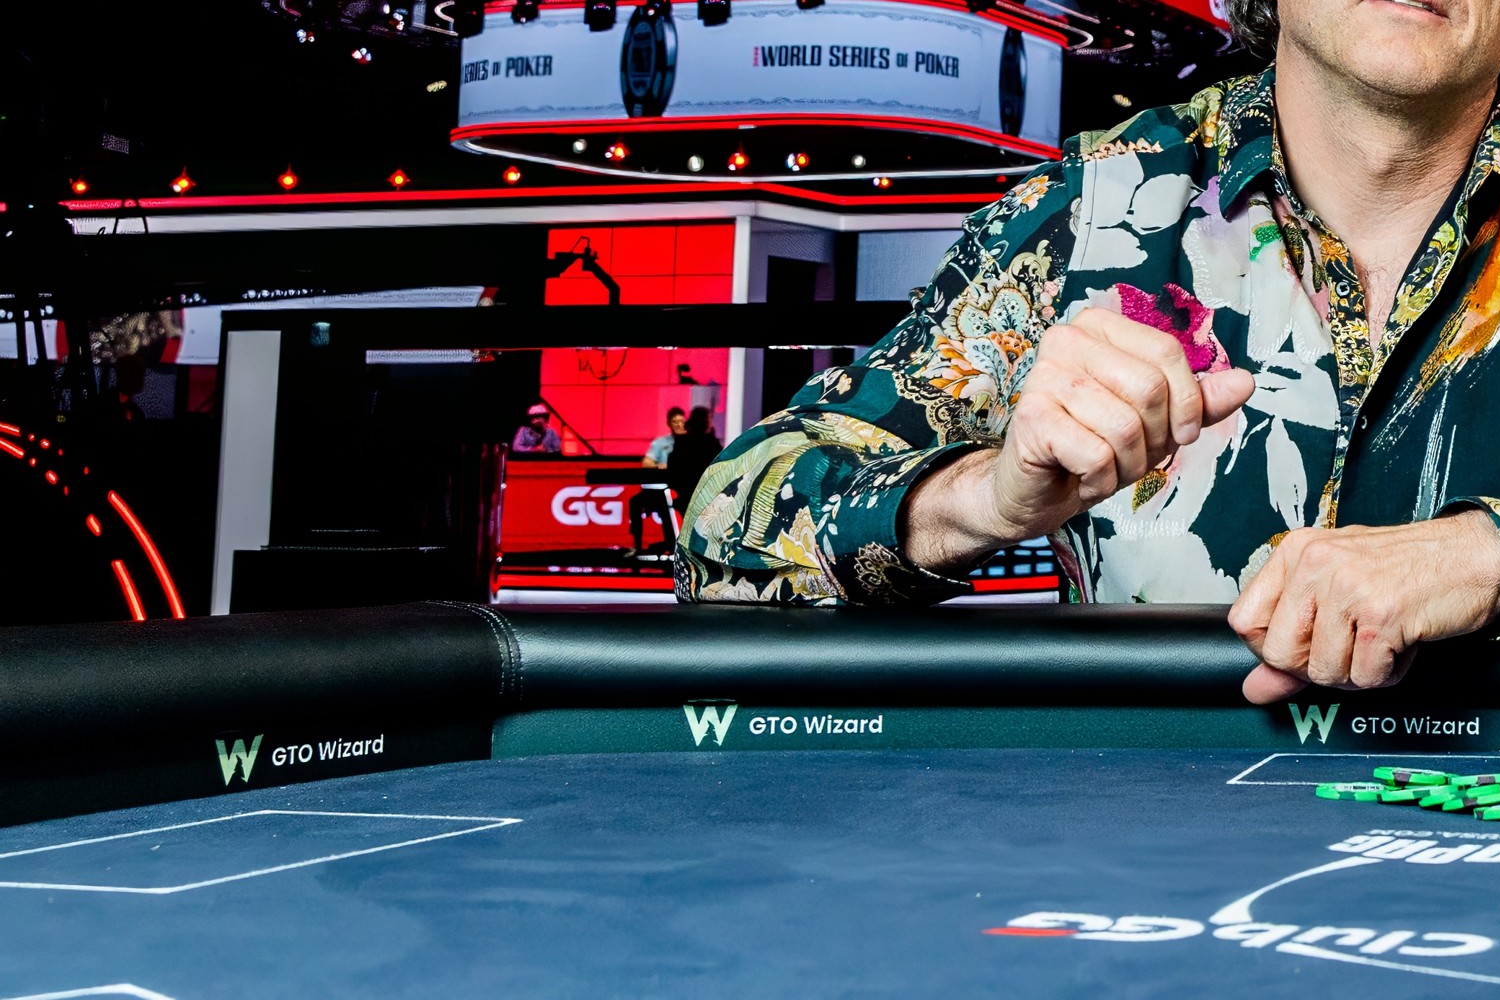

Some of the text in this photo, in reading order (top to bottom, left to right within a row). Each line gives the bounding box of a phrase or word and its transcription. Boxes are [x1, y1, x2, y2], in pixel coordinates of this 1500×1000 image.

[505, 54, 553, 78] POKER
[761, 45, 822, 67] WORLD
[829, 45, 890, 70] SERIES
[914, 50, 960, 79] POKER
[749, 716, 798, 735] GTO
[803, 714, 883, 734] Wizard
[1351, 716, 1397, 734] GTO
[1403, 716, 1480, 735] Wizard
[271, 744, 313, 767] GTO
[318, 733, 384, 761] Wizard
